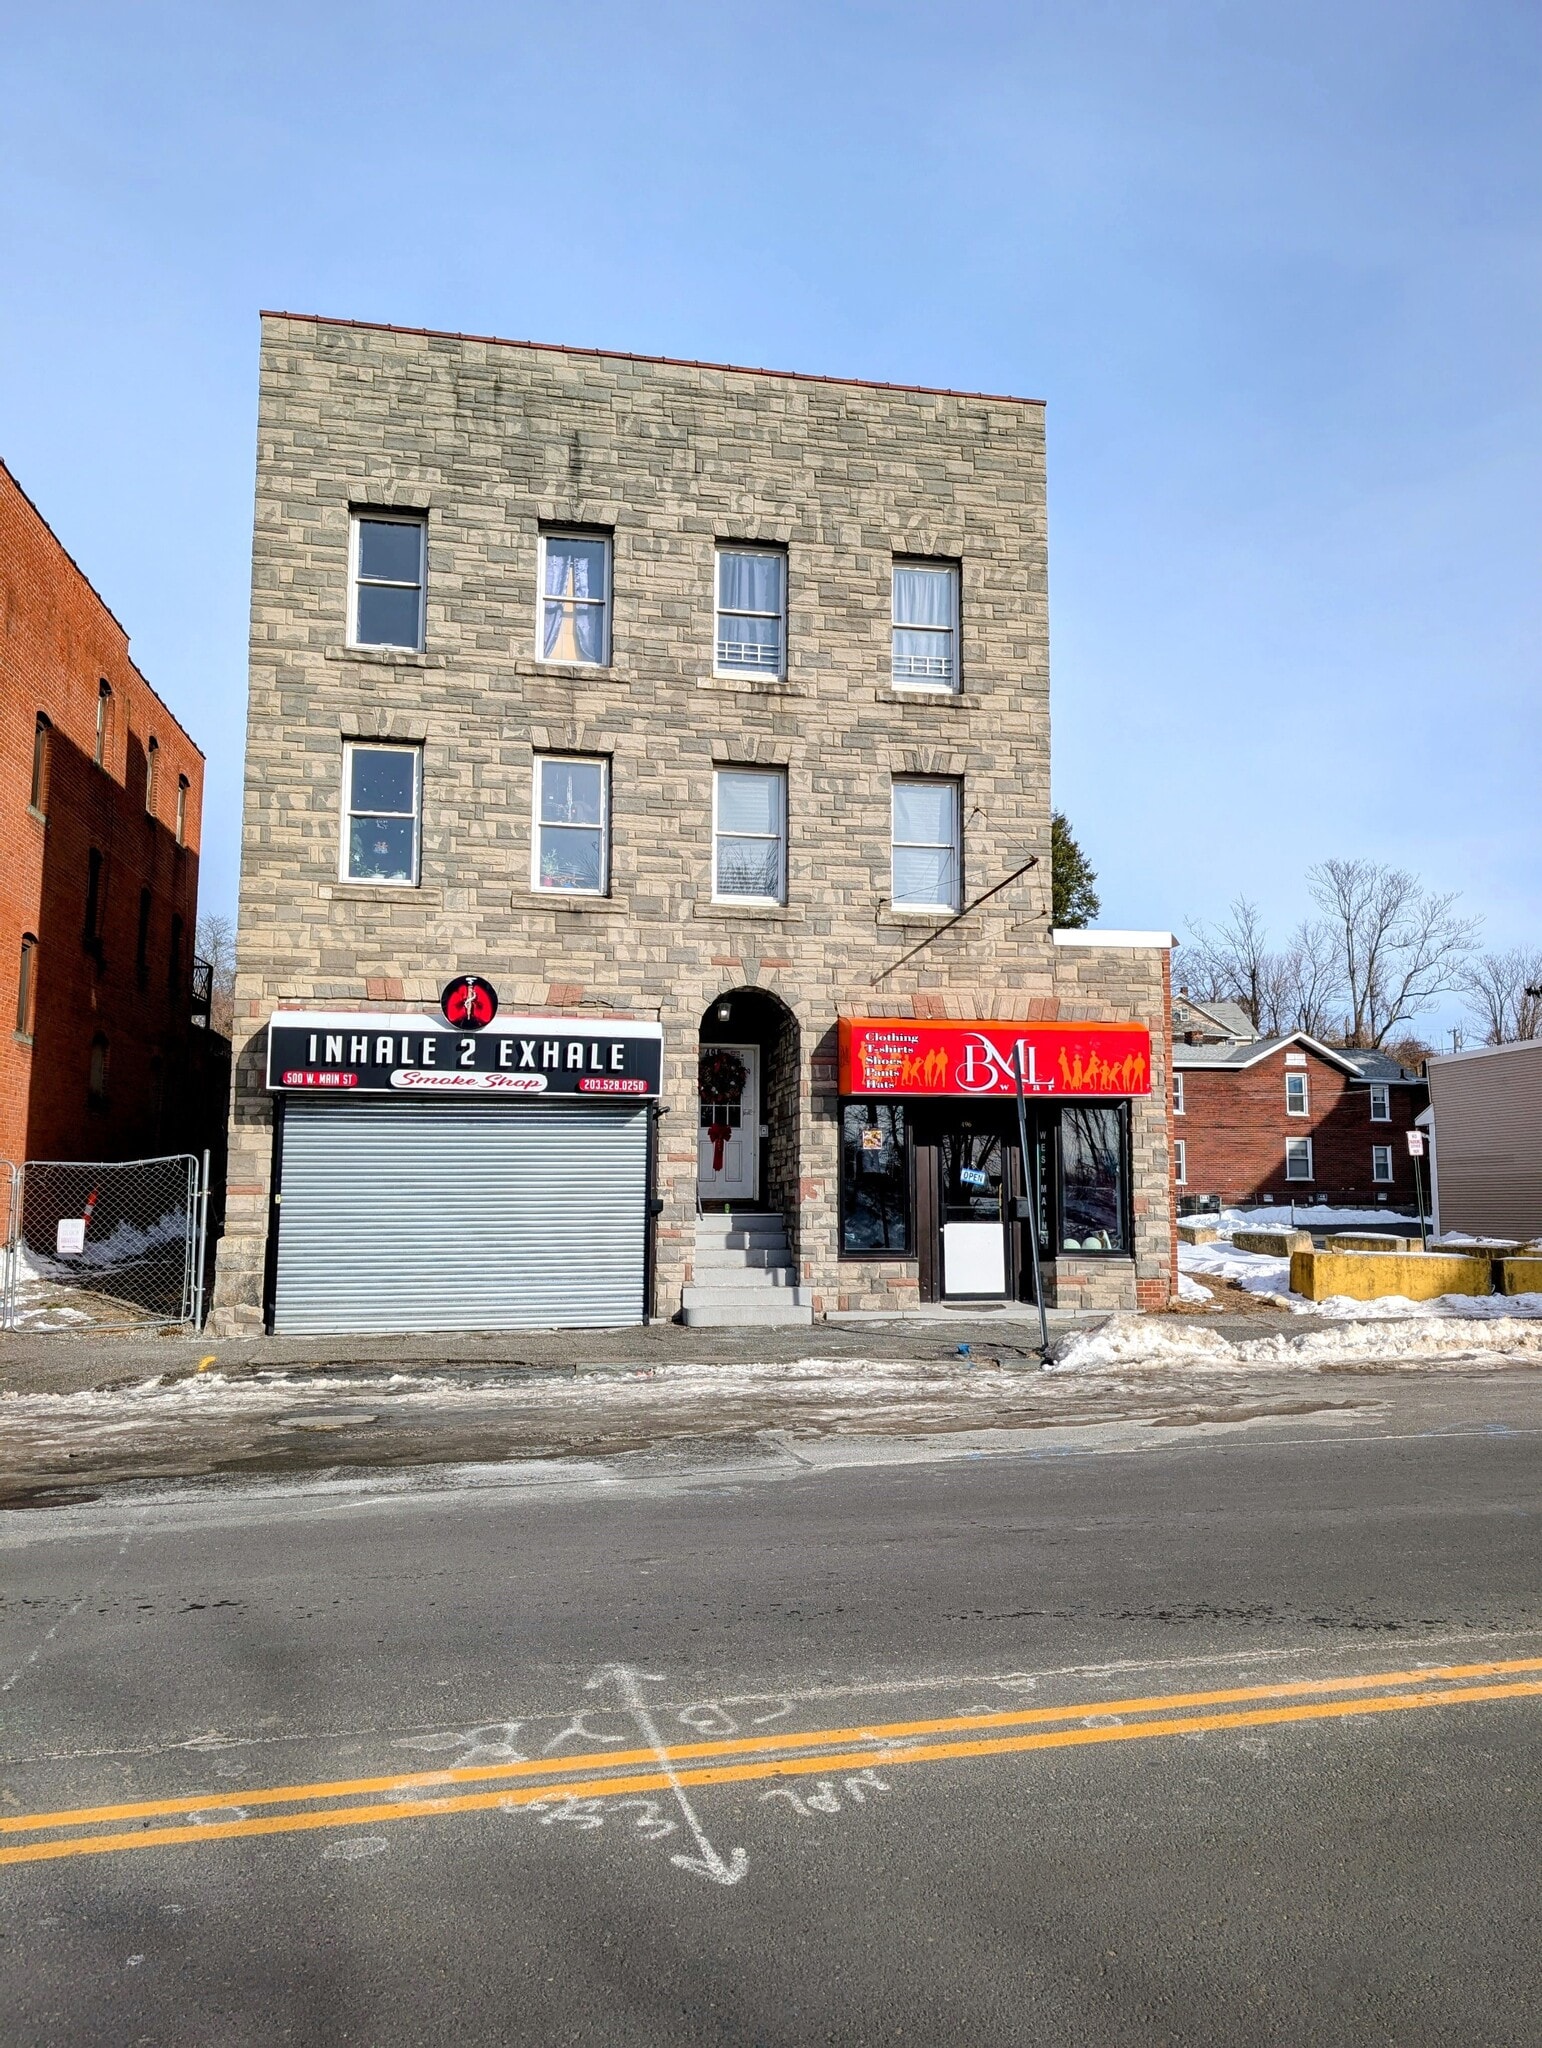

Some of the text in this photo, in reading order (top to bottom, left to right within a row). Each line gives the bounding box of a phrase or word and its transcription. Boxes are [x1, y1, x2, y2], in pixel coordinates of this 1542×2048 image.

[865, 1032, 919, 1044] Clothing
[308, 1034, 625, 1070] INHALE 2 EXHALE
[865, 1044, 914, 1054] T-shirts
[865, 1055, 903, 1066] Shoes
[865, 1067, 900, 1077] Pants
[287, 1072, 353, 1085] 500 W. MAIN ST
[395, 1071, 542, 1090] Smoke Shop
[866, 1079, 896, 1089] Hats
[584, 1079, 644, 1091] 203.528.0250
[1000, 1083, 1055, 1092] war
[1040, 1131, 1048, 1176] WEST
[963, 1170, 985, 1184] OPEN
